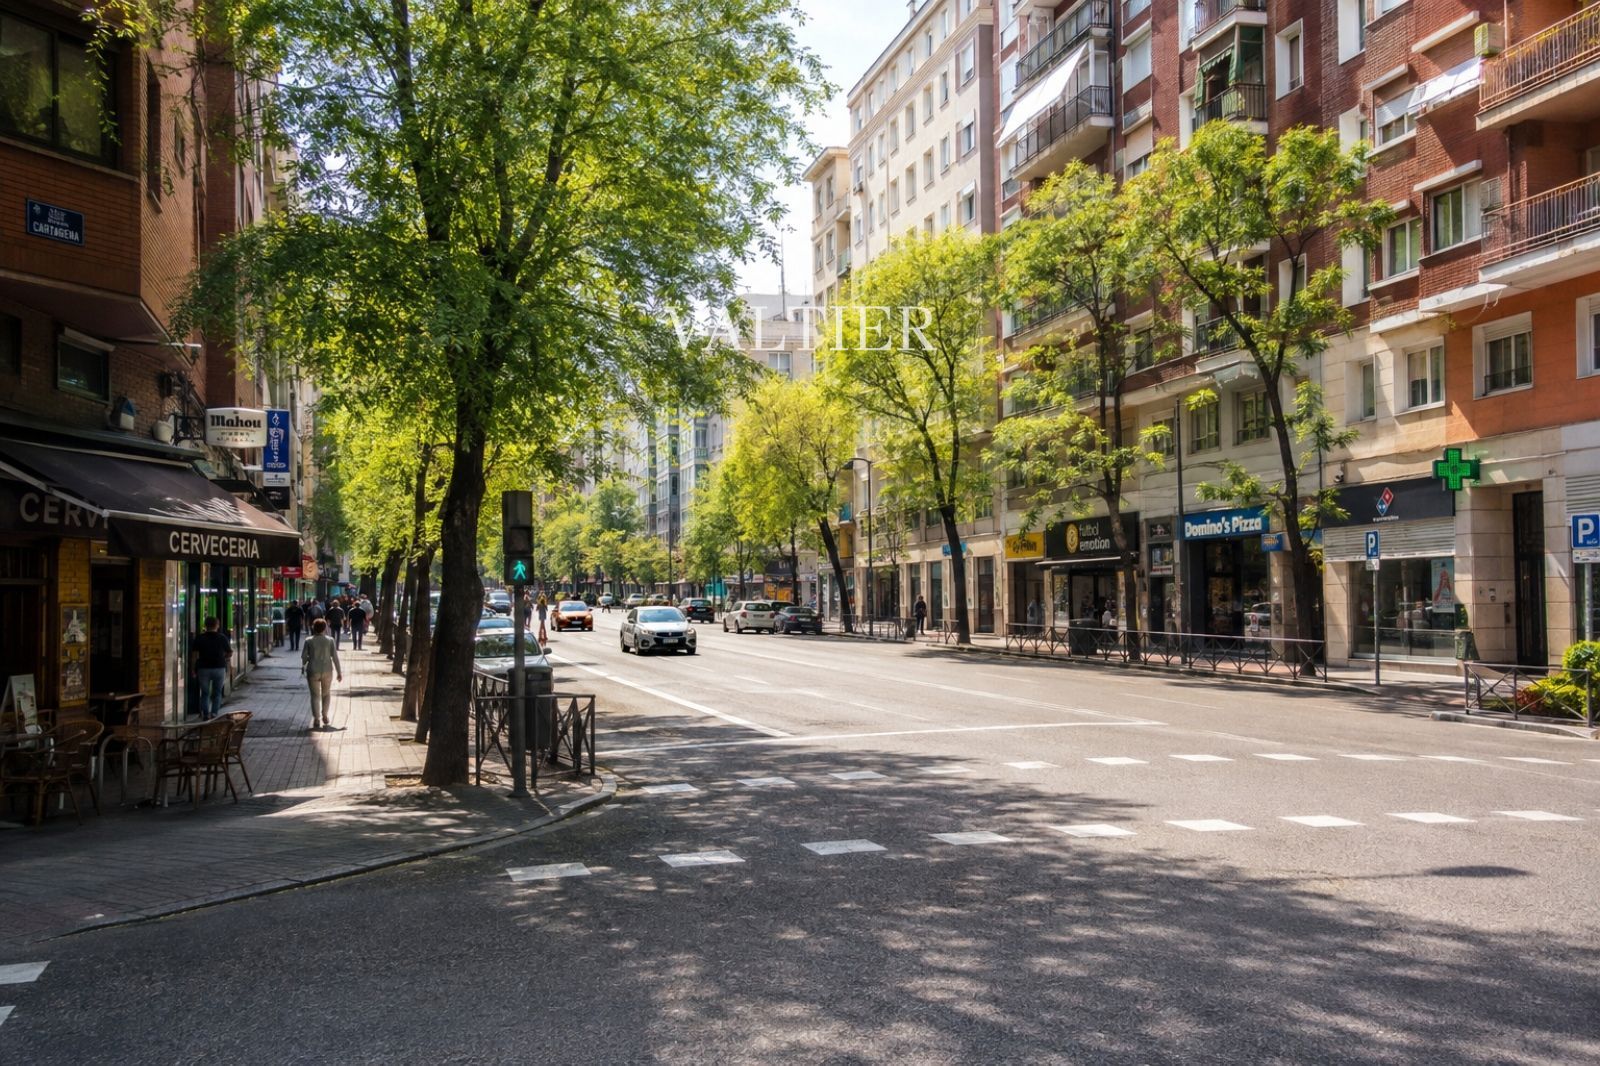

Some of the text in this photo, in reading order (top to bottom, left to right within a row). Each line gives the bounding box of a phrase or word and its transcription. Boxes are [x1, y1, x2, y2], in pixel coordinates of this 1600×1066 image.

[32, 221, 80, 243] CARTAGENA
[209, 414, 263, 429] Mahou
[1184, 515, 1263, 538] Domino's Pizza
[1578, 518, 1595, 544] P
[169, 530, 260, 559] CERVECERIA
[1079, 536, 1111, 552] emotion
[1368, 533, 1376, 555] P
